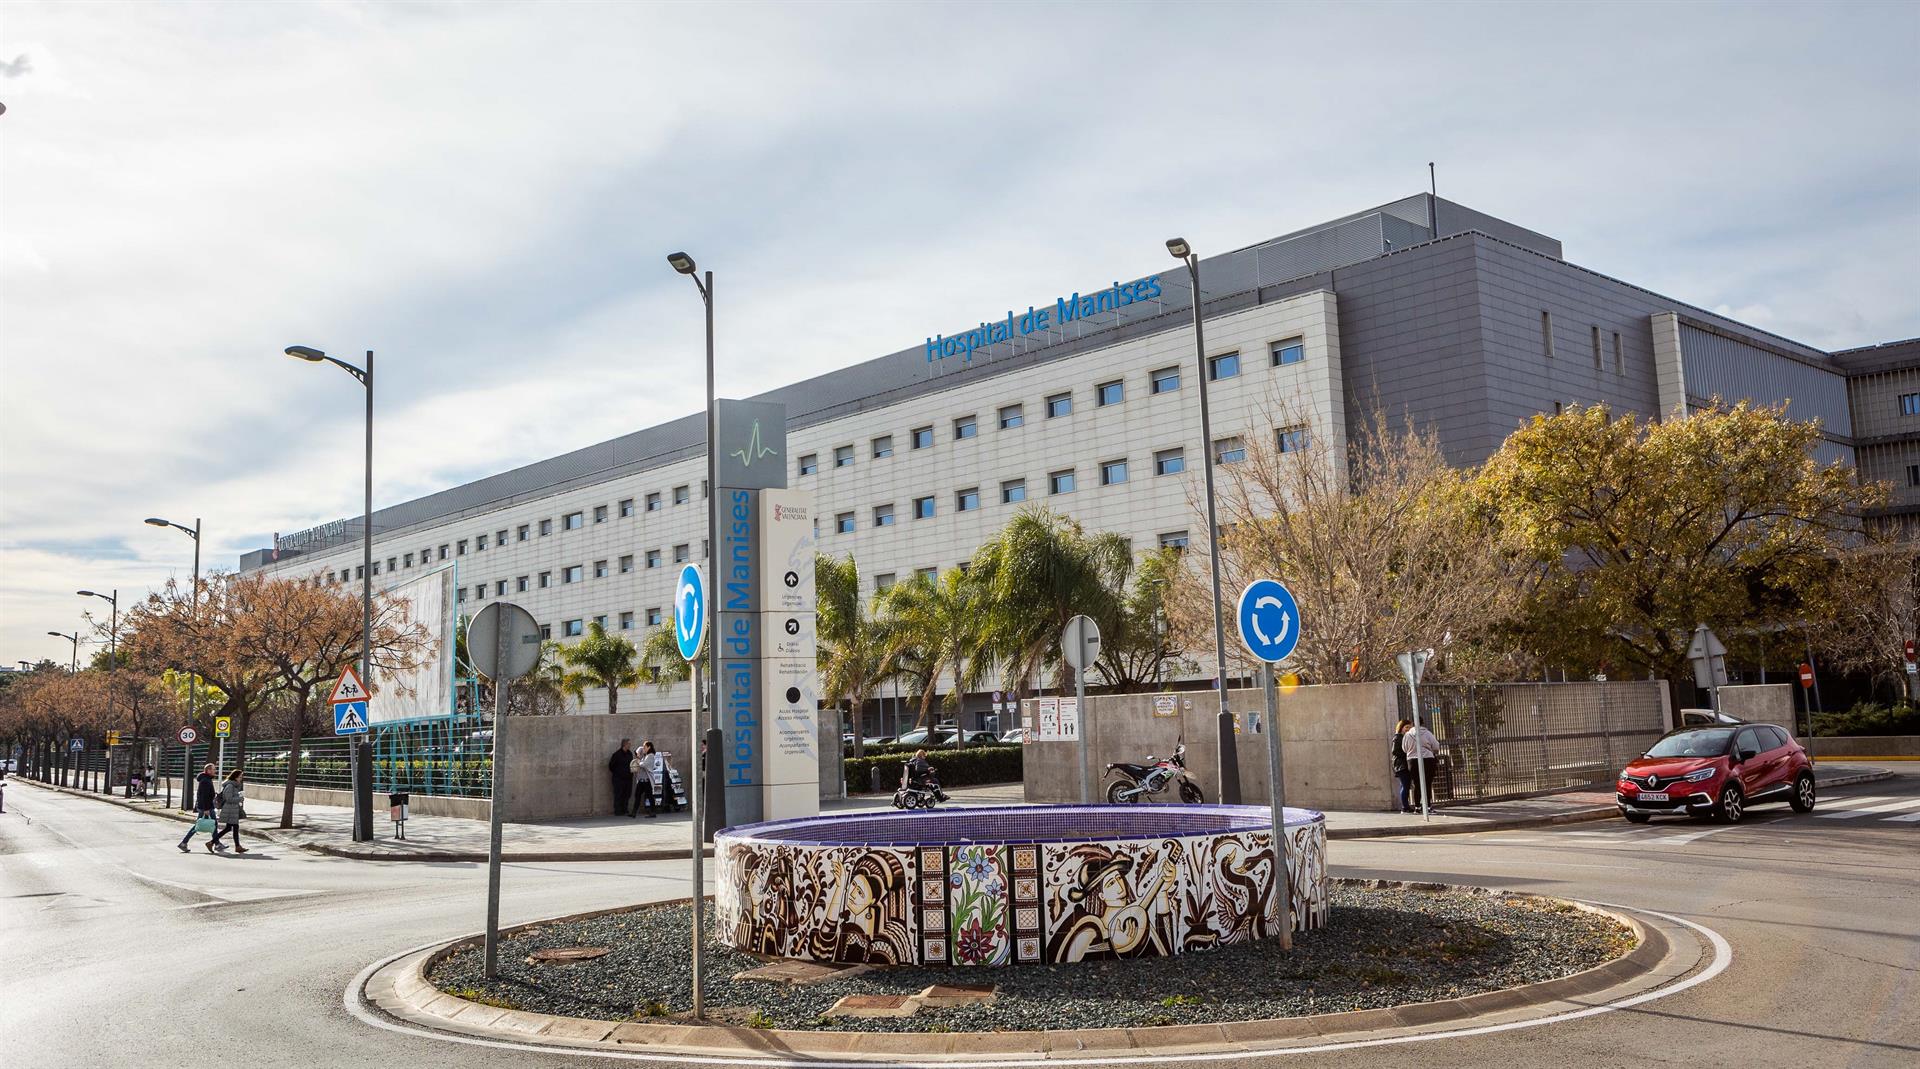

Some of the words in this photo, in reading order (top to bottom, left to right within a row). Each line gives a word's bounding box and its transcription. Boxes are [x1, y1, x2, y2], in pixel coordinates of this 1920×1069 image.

[926, 311, 1014, 363] Hospital
[1020, 306, 1050, 336] de
[1057, 275, 1162, 325] Manises
[726, 490, 752, 609] Manises
[726, 619, 752, 656] de
[726, 663, 758, 785] Hospital
